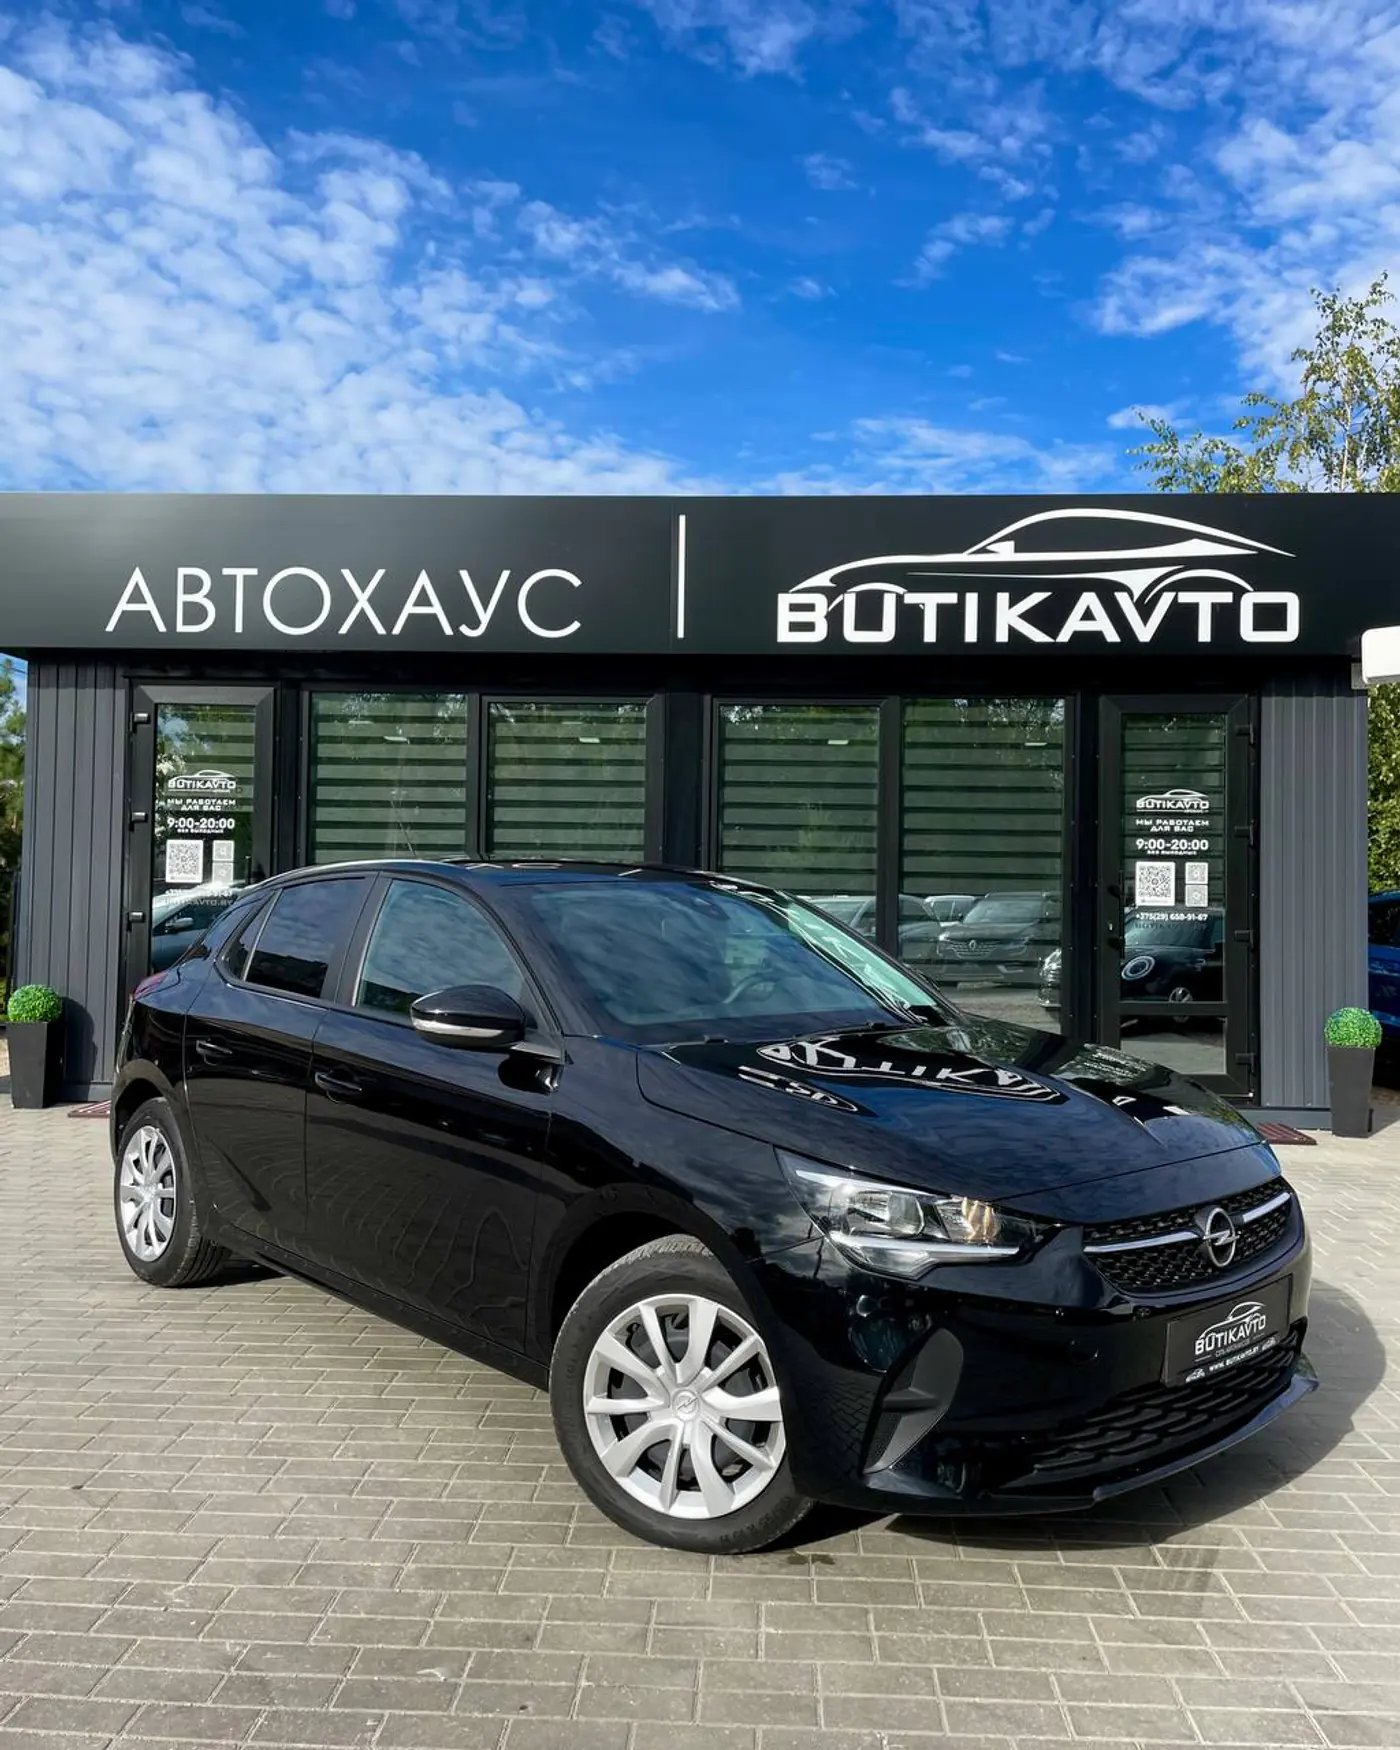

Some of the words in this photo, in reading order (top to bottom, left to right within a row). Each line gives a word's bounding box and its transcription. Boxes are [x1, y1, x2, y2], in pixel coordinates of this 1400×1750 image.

[105, 566, 582, 639] АВТОХАУС
[777, 592, 1299, 643] BUTIKAVTO
[168, 780, 236, 789] BUTIKAVTO
[1136, 800, 1210, 809] BUTIKAVTO
[167, 817, 236, 829] 9:00-20:00
[1136, 838, 1209, 850] 9:00-20:00
[1195, 1315, 1266, 1355] BUTIKAVTO
